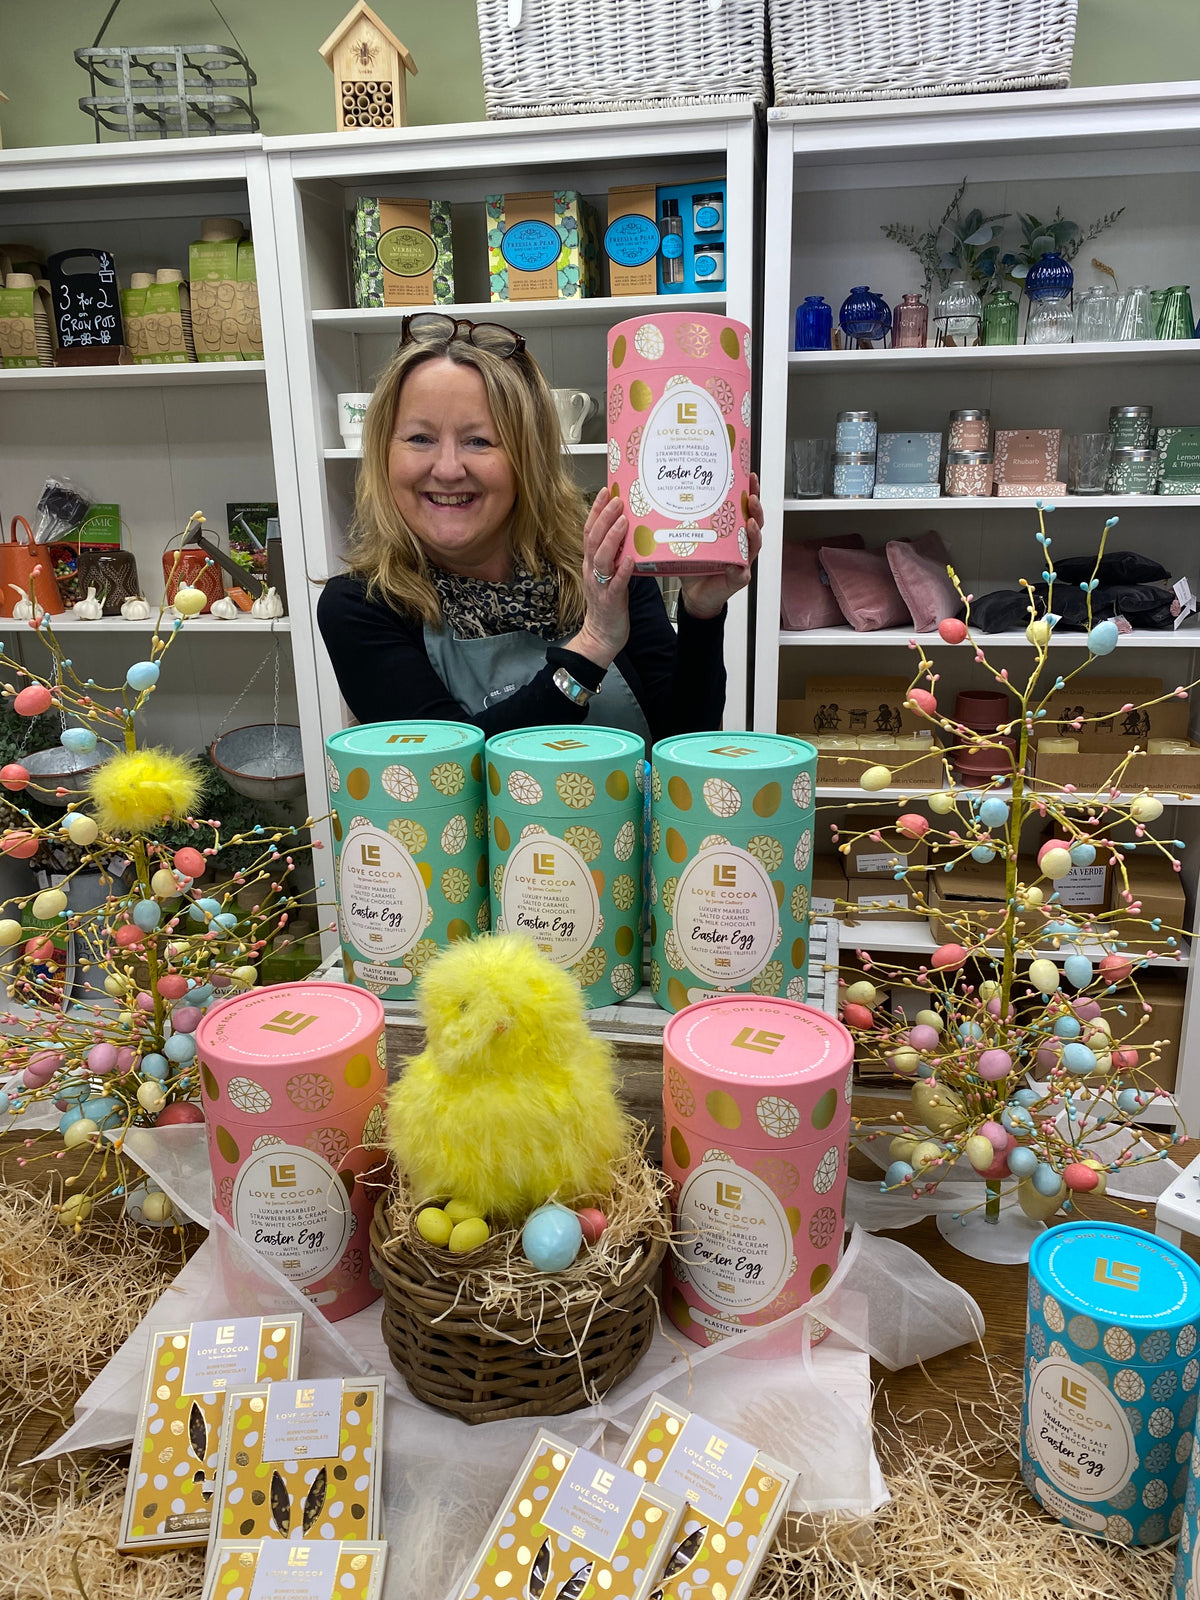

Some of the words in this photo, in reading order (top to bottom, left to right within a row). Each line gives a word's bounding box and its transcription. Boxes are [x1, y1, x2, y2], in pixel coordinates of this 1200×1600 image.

[60, 284, 70, 310] 3
[76, 292, 93, 310] for
[97, 288, 113, 308] 2
[60, 314, 92, 337] GROW
[94, 315, 116, 330] POTS
[657, 428, 680, 436] LOVE
[684, 428, 715, 436] COCOA
[892, 460, 923, 468] Geranium
[657, 465, 691, 480] Easter
[694, 465, 714, 486] Egg
[348, 866, 366, 876] LOVE
[368, 870, 402, 878] COCOA
[515, 875, 536, 884] LOVE
[1080, 868, 1104, 876] VERDE
[692, 888, 716, 898] LOVE
[351, 902, 378, 919] Easter
[380, 908, 403, 928] Egg
[700, 912, 720, 920] SALTED
[516, 912, 550, 930] Easter
[552, 916, 576, 937] Egg
[691, 926, 728, 943] Easter
[730, 930, 756, 950] Egg
[362, 972, 378, 980] SINGLE
[380, 974, 398, 982] ORIGIN
[363, 966, 382, 975] PLASTIC
[270, 992, 292, 1000] TREE
[793, 1016, 813, 1026] ONE
[814, 1024, 829, 1036] TREE
[248, 1190, 276, 1199] LOVE
[280, 1187, 323, 1199] COCOA
[250, 1213, 296, 1222] STRAWBERRIES
[304, 1210, 328, 1219] CREAM
[285, 1206, 316, 1214] MARBLED
[694, 1200, 720, 1216] LOVE
[724, 1212, 767, 1226] COCOA
[287, 1216, 328, 1228] CHOCOLATE
[254, 1228, 295, 1246] Easter
[298, 1228, 325, 1249] Egg
[706, 1236, 725, 1248] WHITE
[726, 1244, 768, 1256] CHOCOLATE
[302, 1246, 329, 1255] TRUFFLES
[720, 1268, 735, 1276] WITH
[735, 1256, 764, 1280] Egg
[712, 1270, 736, 1282] CARAMEL
[738, 1278, 766, 1286] TRUFFLES
[704, 1318, 730, 1332] PLASTIC
[197, 1348, 218, 1356] LOVE
[220, 1345, 249, 1354] COCOA
[276, 1412, 297, 1420] LOVE
[300, 1410, 330, 1418] COCOA
[1040, 1386, 1064, 1410] LOVE
[1068, 1408, 1112, 1432] COCOA
[1043, 1418, 1059, 1433] DARK
[1060, 1432, 1106, 1457] CHOCOLATE
[1073, 1432, 1086, 1442] SEA
[1090, 1439, 1109, 1450] SALT
[1040, 1426, 1076, 1458] Easter
[1077, 1452, 1106, 1478] Egg
[683, 1446, 704, 1462] LOVE
[705, 1460, 733, 1480] COCOA
[570, 1482, 590, 1497] LOVE
[592, 1494, 620, 1514] COCOA
[1045, 1487, 1064, 1505] VEGAN
[1064, 1502, 1093, 1520] FRIENDLY
[1049, 1497, 1072, 1516] PLASTIC
[1072, 1513, 1086, 1522] FREE
